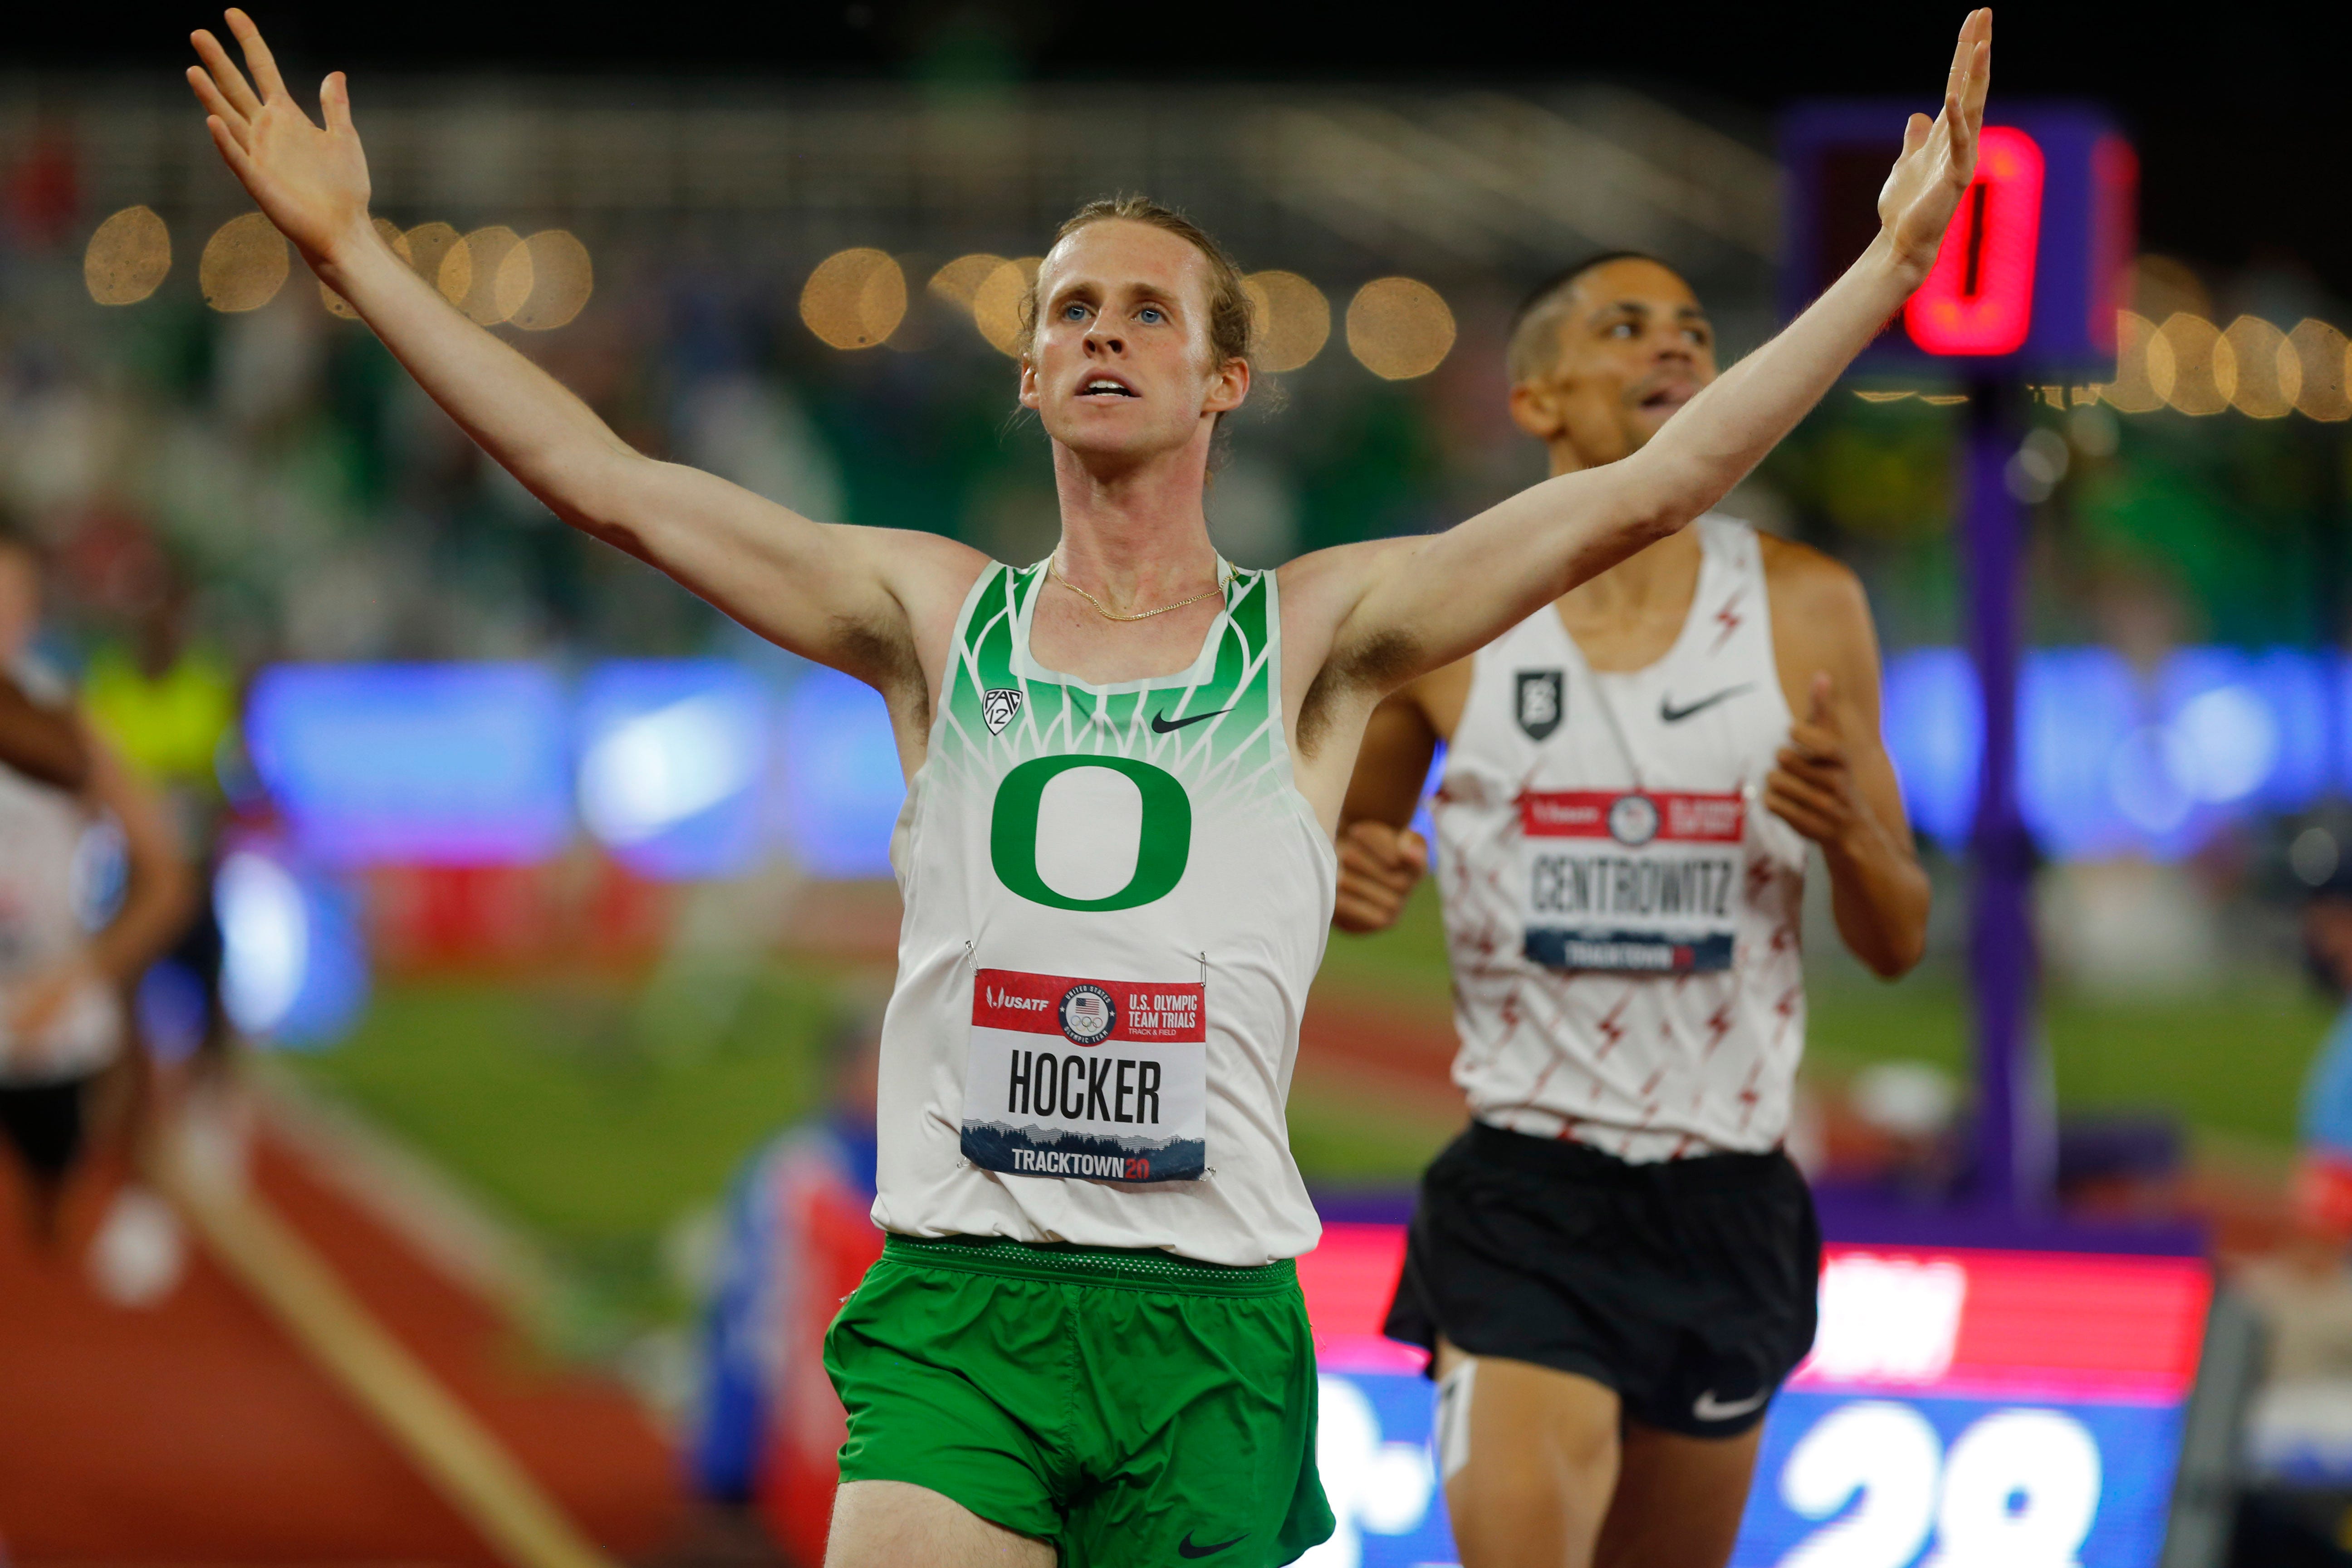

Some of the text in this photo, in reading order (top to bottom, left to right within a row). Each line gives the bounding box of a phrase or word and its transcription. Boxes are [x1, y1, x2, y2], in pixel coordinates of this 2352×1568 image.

[985, 691, 1020, 715] PAC
[989, 708, 1009, 724] 12
[990, 754, 1191, 912] O
[1532, 856, 1732, 915] CENTROWITZ
[1004, 995, 1049, 1012] USATF
[1065, 985, 1111, 1004] UNITED STATES
[1129, 994, 1198, 1011] U.S. OLYMPIC
[1128, 1011, 1196, 1029] TEAM TRIALS
[1063, 1026, 1108, 1043] OLYMPIC TEAM
[1009, 1049, 1161, 1124] HOCKER
